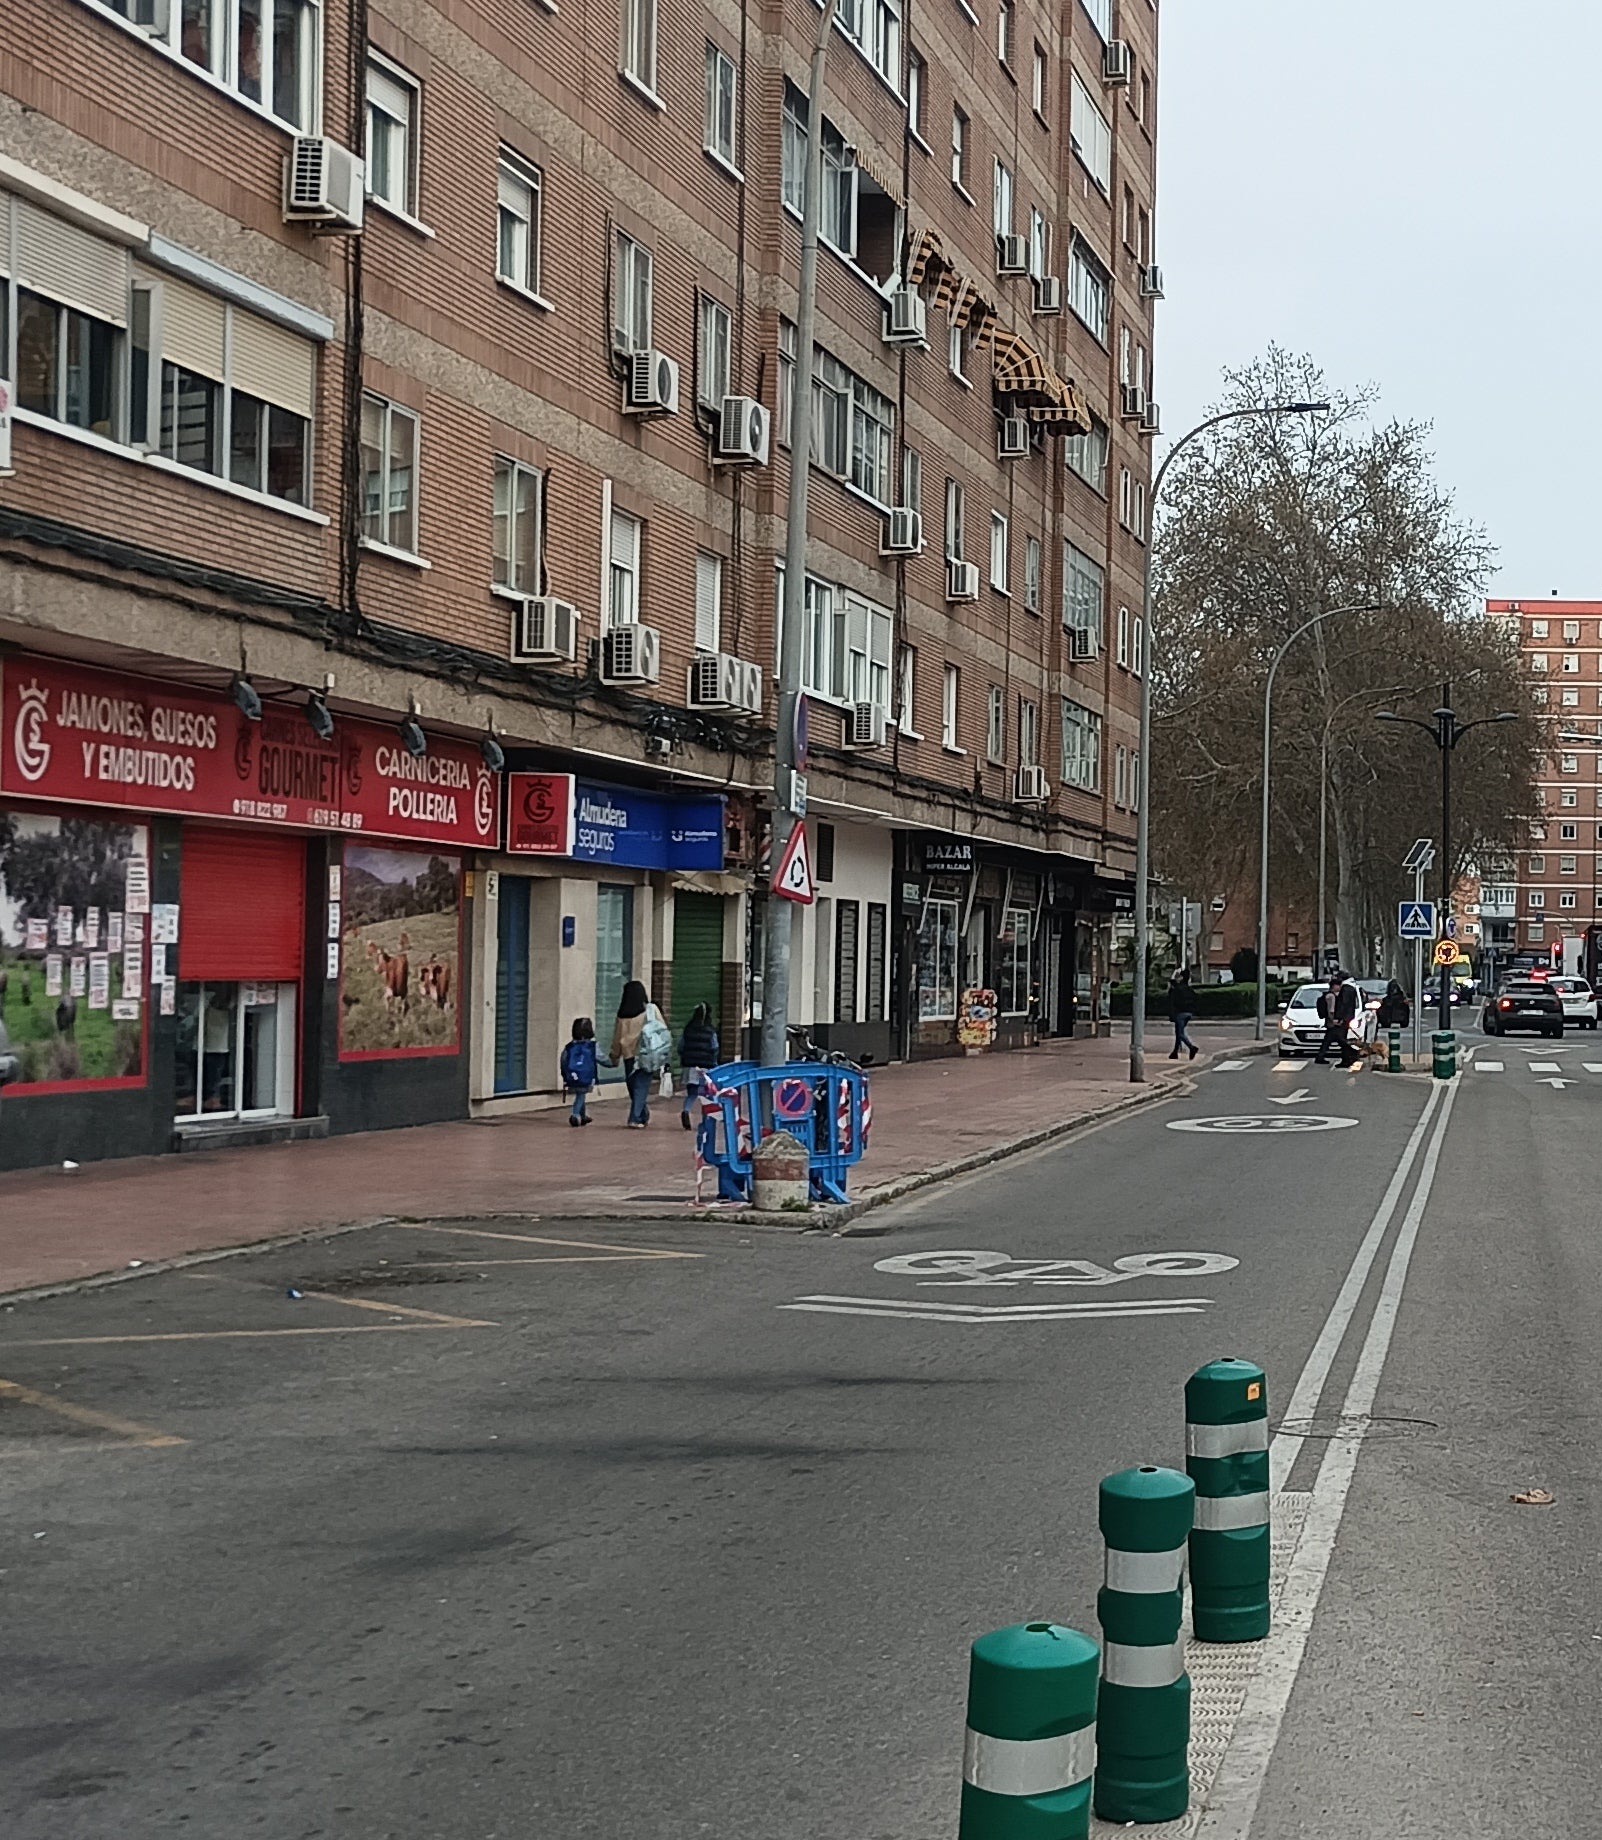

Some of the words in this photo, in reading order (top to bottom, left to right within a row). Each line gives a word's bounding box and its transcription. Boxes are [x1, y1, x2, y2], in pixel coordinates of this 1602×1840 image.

[56, 690, 148, 742] JAMONES,
[151, 706, 217, 749] QUESOS
[82, 741, 96, 778] Y
[98, 744, 196, 791] EMBUTIDOS
[258, 744, 340, 804] GOURMET
[375, 745, 470, 790] CARNICERIA
[388, 786, 458, 825] POLLERIA
[578, 797, 627, 828] Almudena
[578, 828, 615, 855] seguros
[926, 844, 972, 859] BAZAR
